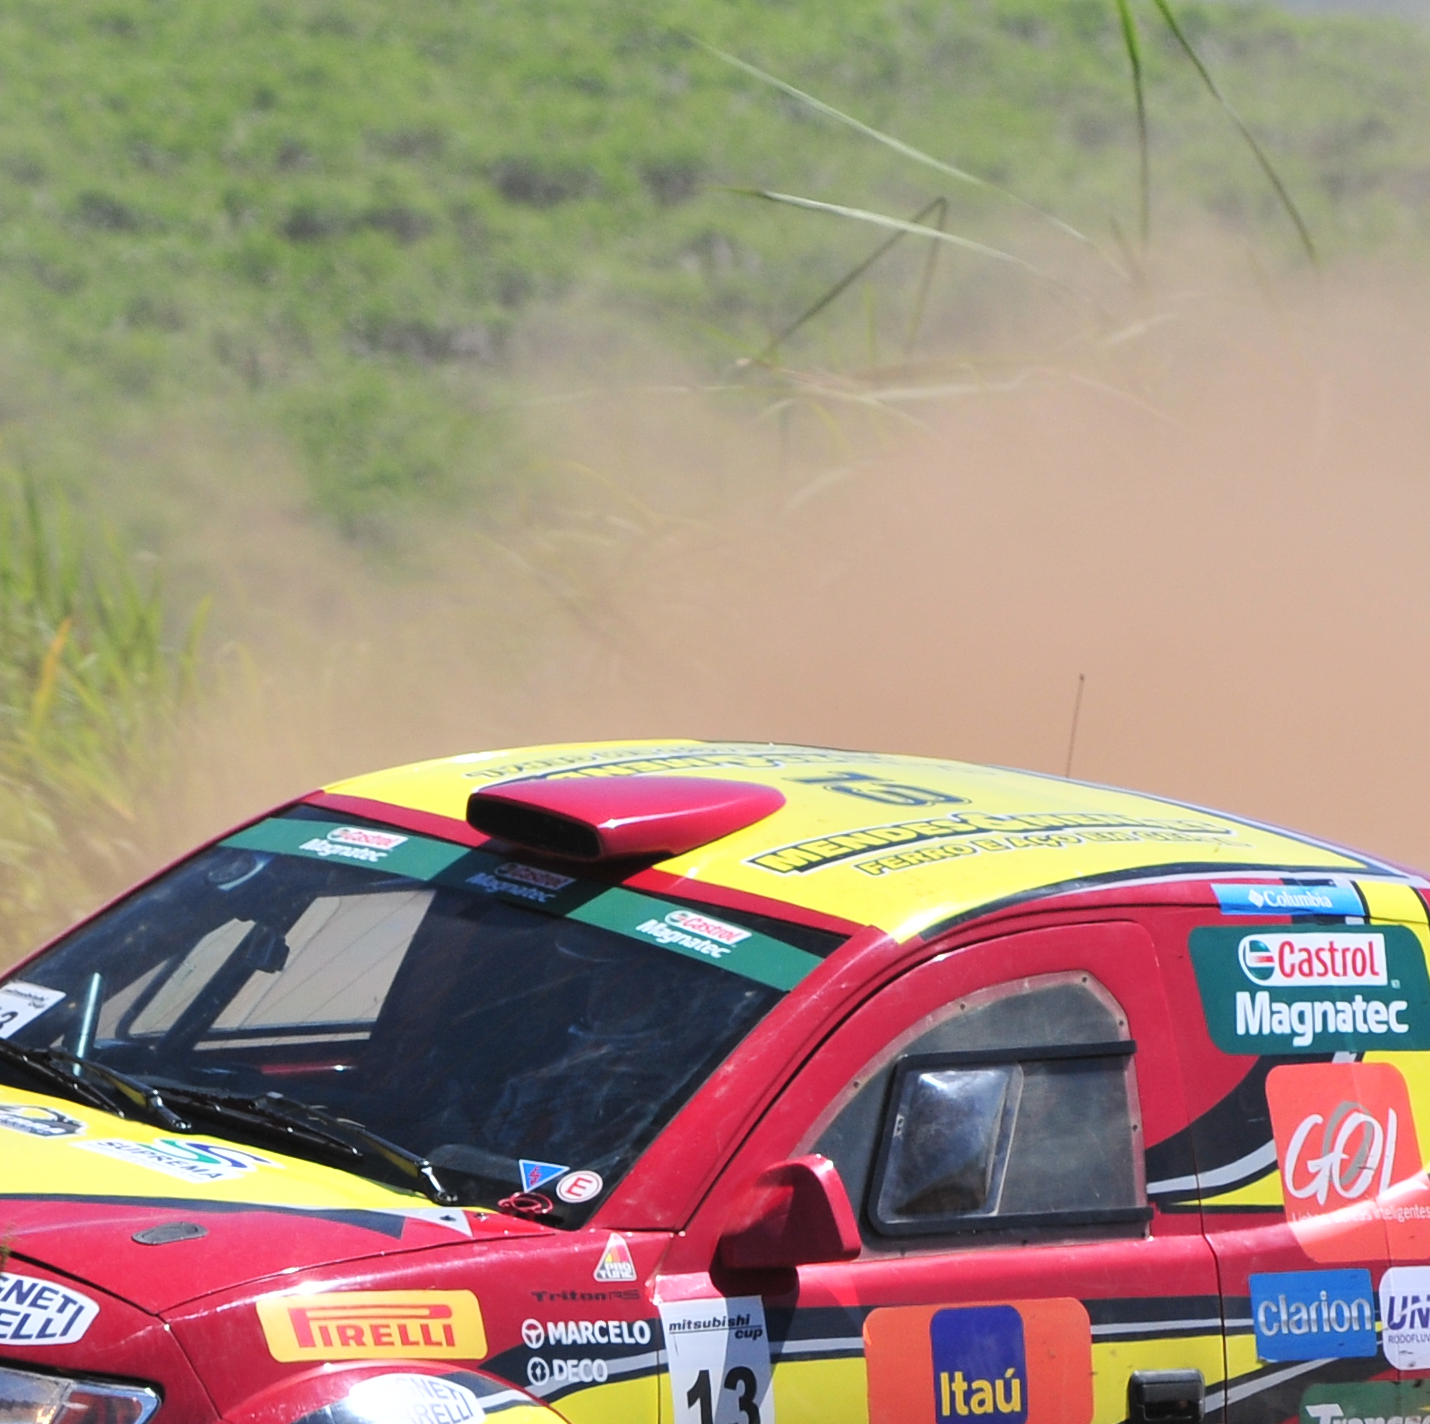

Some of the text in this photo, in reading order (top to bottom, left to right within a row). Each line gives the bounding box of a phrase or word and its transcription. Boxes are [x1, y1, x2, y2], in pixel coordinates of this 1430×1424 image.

[754, 819, 975, 872] MENDES
[857, 845, 976, 874] FERRO
[1263, 889, 1333, 908] Columbia
[635, 919, 731, 958] Magnatec
[1278, 940, 1380, 979] Castrol
[1235, 991, 1409, 1047] Magnatec
[97, 1141, 224, 1179] SUPREMA
[1285, 1101, 1398, 1205] GOL
[565, 1176, 593, 1197] E
[531, 1290, 607, 1302] Triton
[1257, 1290, 1372, 1336] clarion
[288, 1304, 456, 1348] PIRELLI
[547, 1319, 652, 1345] MARCELO
[669, 1313, 751, 1331] mitsubishi
[734, 1327, 763, 1341] cup
[552, 1358, 608, 1383] DECO
[940, 1367, 1021, 1417] Itaú
